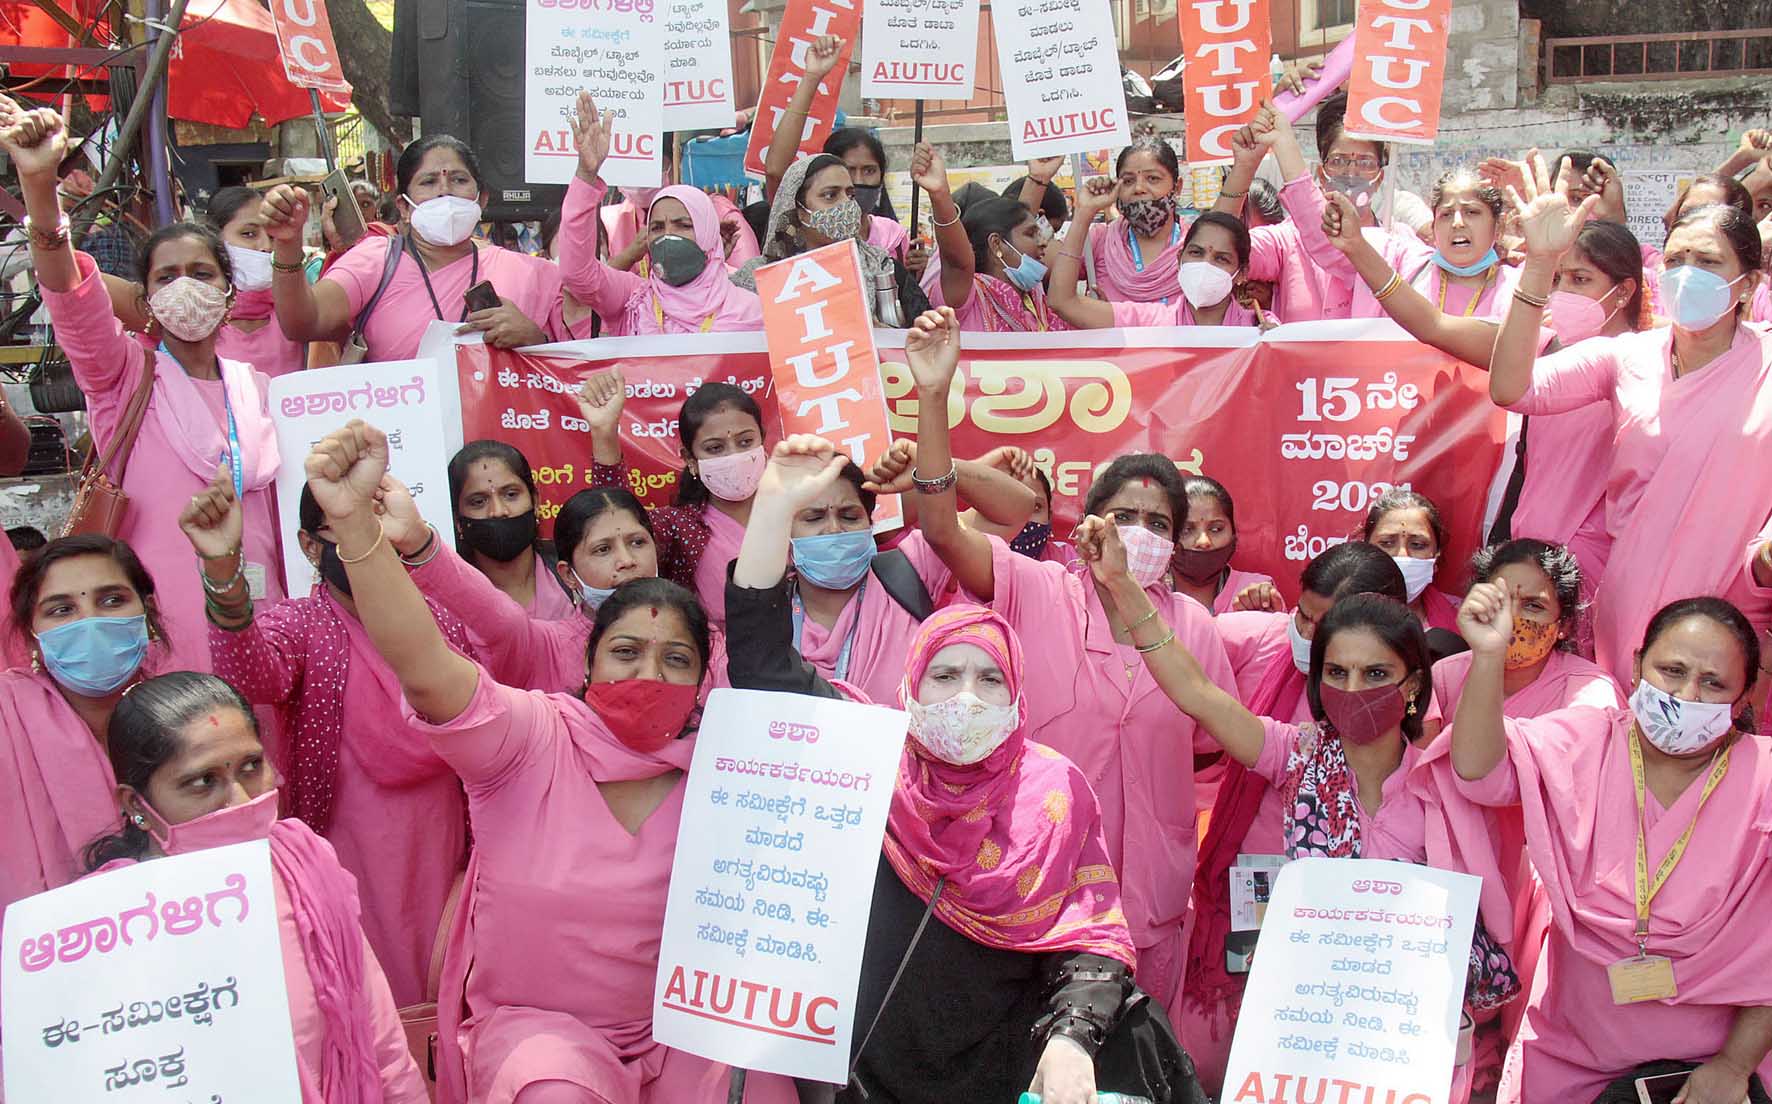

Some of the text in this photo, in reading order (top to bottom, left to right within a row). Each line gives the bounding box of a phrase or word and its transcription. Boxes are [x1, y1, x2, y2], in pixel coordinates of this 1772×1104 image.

[873, 61, 965, 82] AIUTUC
[1023, 108, 1116, 140] AIUTUC
[280, 375, 426, 418] ಆಶಾಗಳಿಗೆ
[1296, 371, 1418, 422] 15 ನೇ
[501, 408, 550, 431] ಜೊತೆ
[1281, 427, 1416, 461] ಮಾರ್ಚ್
[768, 720, 821, 744] ಆಶಾ
[715, 756, 872, 792] ಕಾರ್ಯಕರ್ತೆಯರಿಗೆ
[711, 785, 863, 830] ಈ ಸಮೀಕ್ಷೆಗೆ ಒತ್ತಡ
[745, 826, 804, 852] ಮಾಡದೆ
[713, 858, 828, 902] ಅಗತ್ಯವಿರುವಷ್ಟು
[1351, 878, 1403, 896] ಆಶಾ
[695, 886, 745, 912] ಸಮಯ
[19, 872, 250, 972] ಆಶಾಗಳಿಗೆ
[696, 922, 749, 958] ಸಮೀಕ್ಷೆ
[1289, 929, 1311, 944] ಈ
[1318, 930, 1393, 954] ಸಮೀಕ್ಷೆಗೆ
[1331, 957, 1392, 975] ಮಾಡದೆ
[42, 976, 239, 1048] ಈ-ಸಮೀಕ್ಷೆಗೆ
[664, 965, 838, 1036] AIUTUC
[1274, 1006, 1333, 1025] ಸಮಯ
[1277, 1033, 1339, 1060] ಸಮೀಕ್ಷೆ
[104, 1044, 188, 1092] ಸೂಕ್ತ
